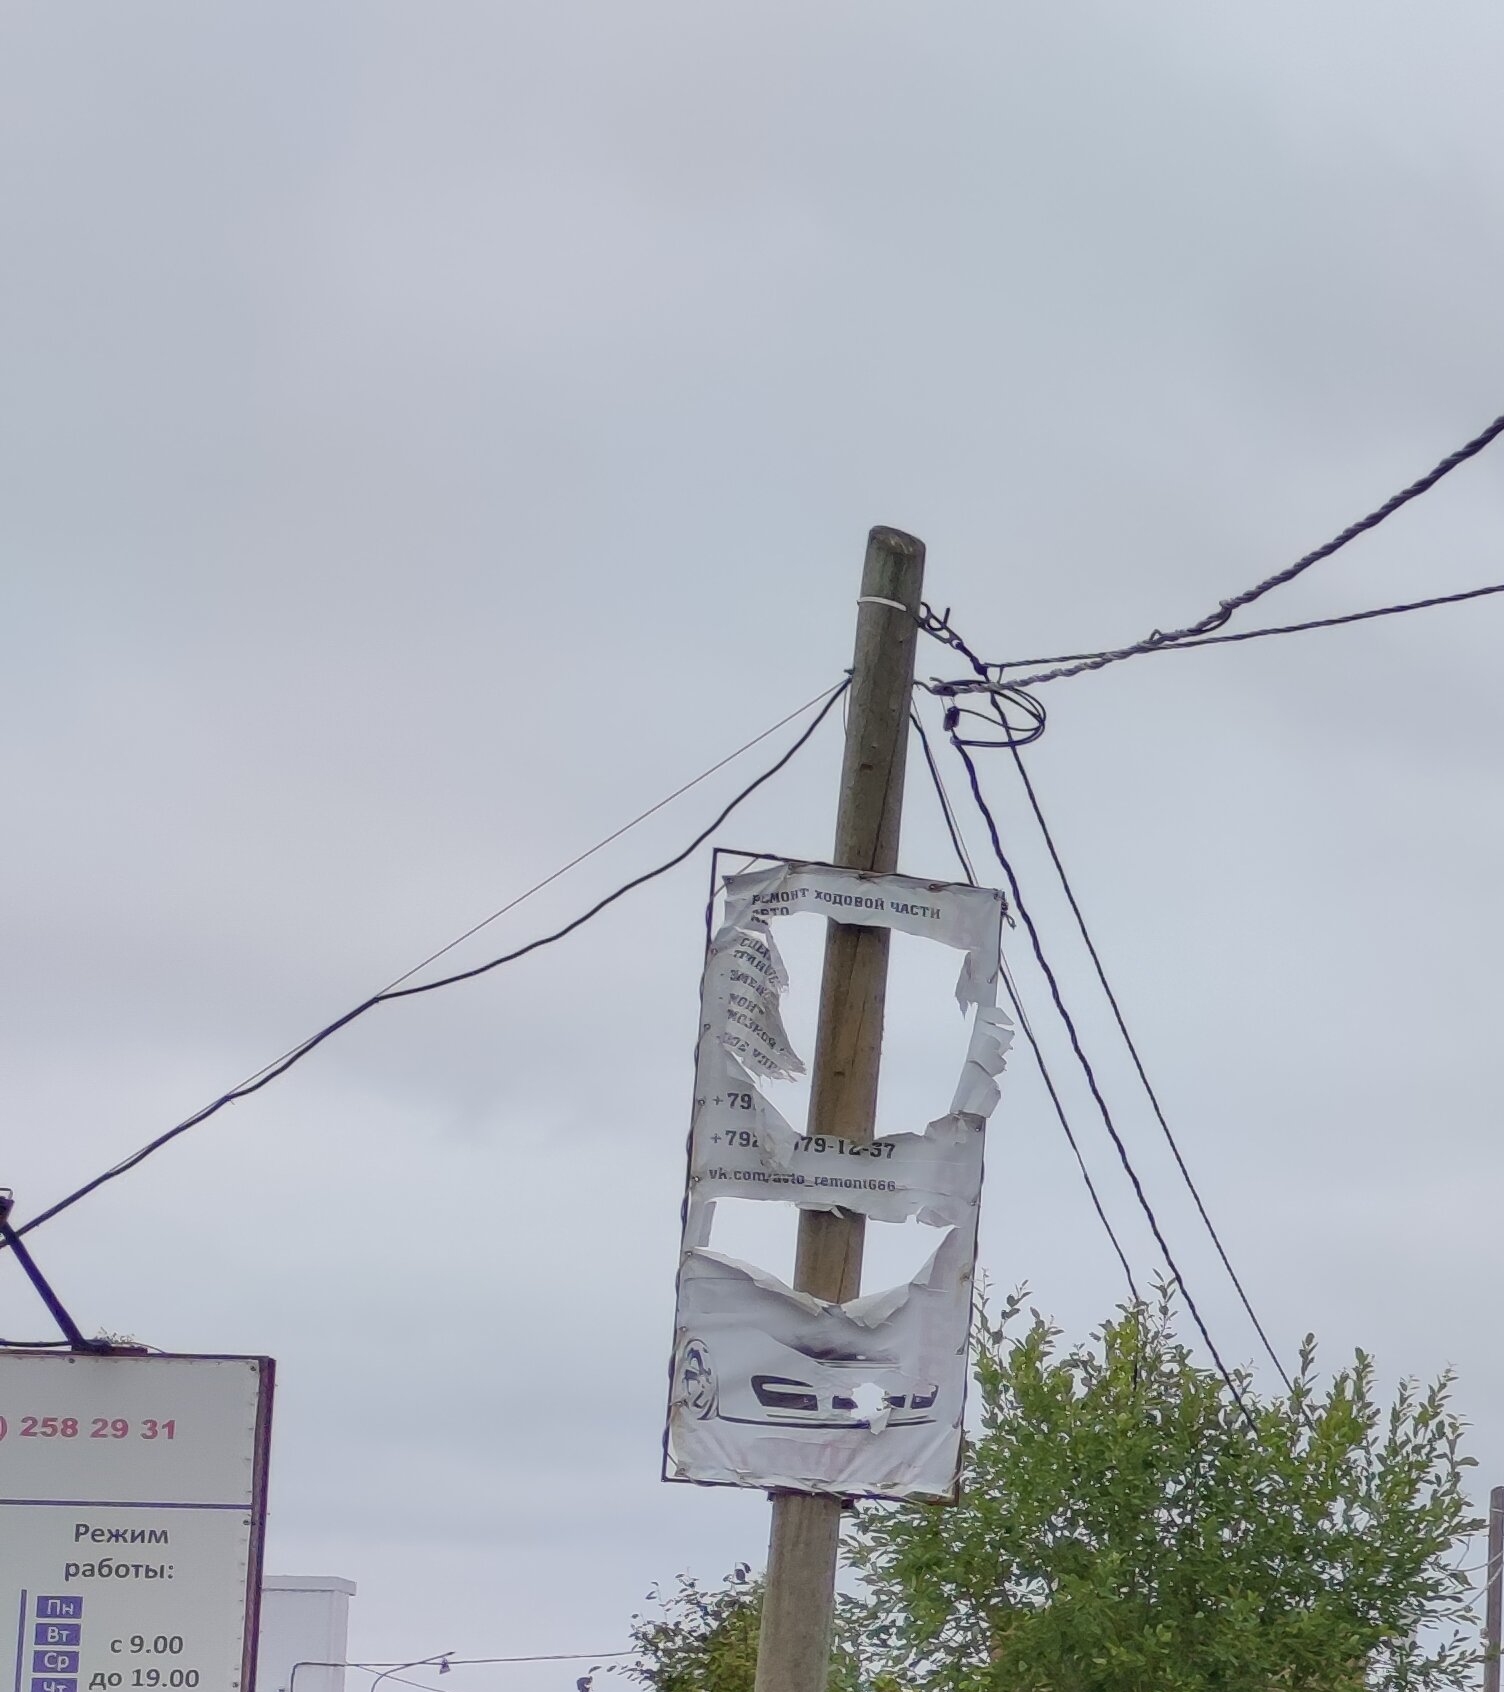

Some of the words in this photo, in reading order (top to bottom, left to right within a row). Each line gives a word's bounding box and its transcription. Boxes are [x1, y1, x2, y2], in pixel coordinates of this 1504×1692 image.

[814, 889, 885, 911] ХОДОВОЙ
[890, 901, 940, 920] ЧАСТИ
[19, 1416, 79, 1438] 258
[90, 1417, 130, 1440] 29
[140, 1419, 177, 1440] 31
[74, 1523, 170, 1545] Режим
[65, 1557, 175, 1582] работы:
[46, 1599, 74, 1616] Пн
[47, 1626, 71, 1643] Вт
[110, 1638, 123, 1654] с
[129, 1635, 184, 1655] 9.00
[44, 1653, 70, 1672] Ср
[88, 1671, 123, 1692] до
[131, 1668, 200, 1688] 19.00
